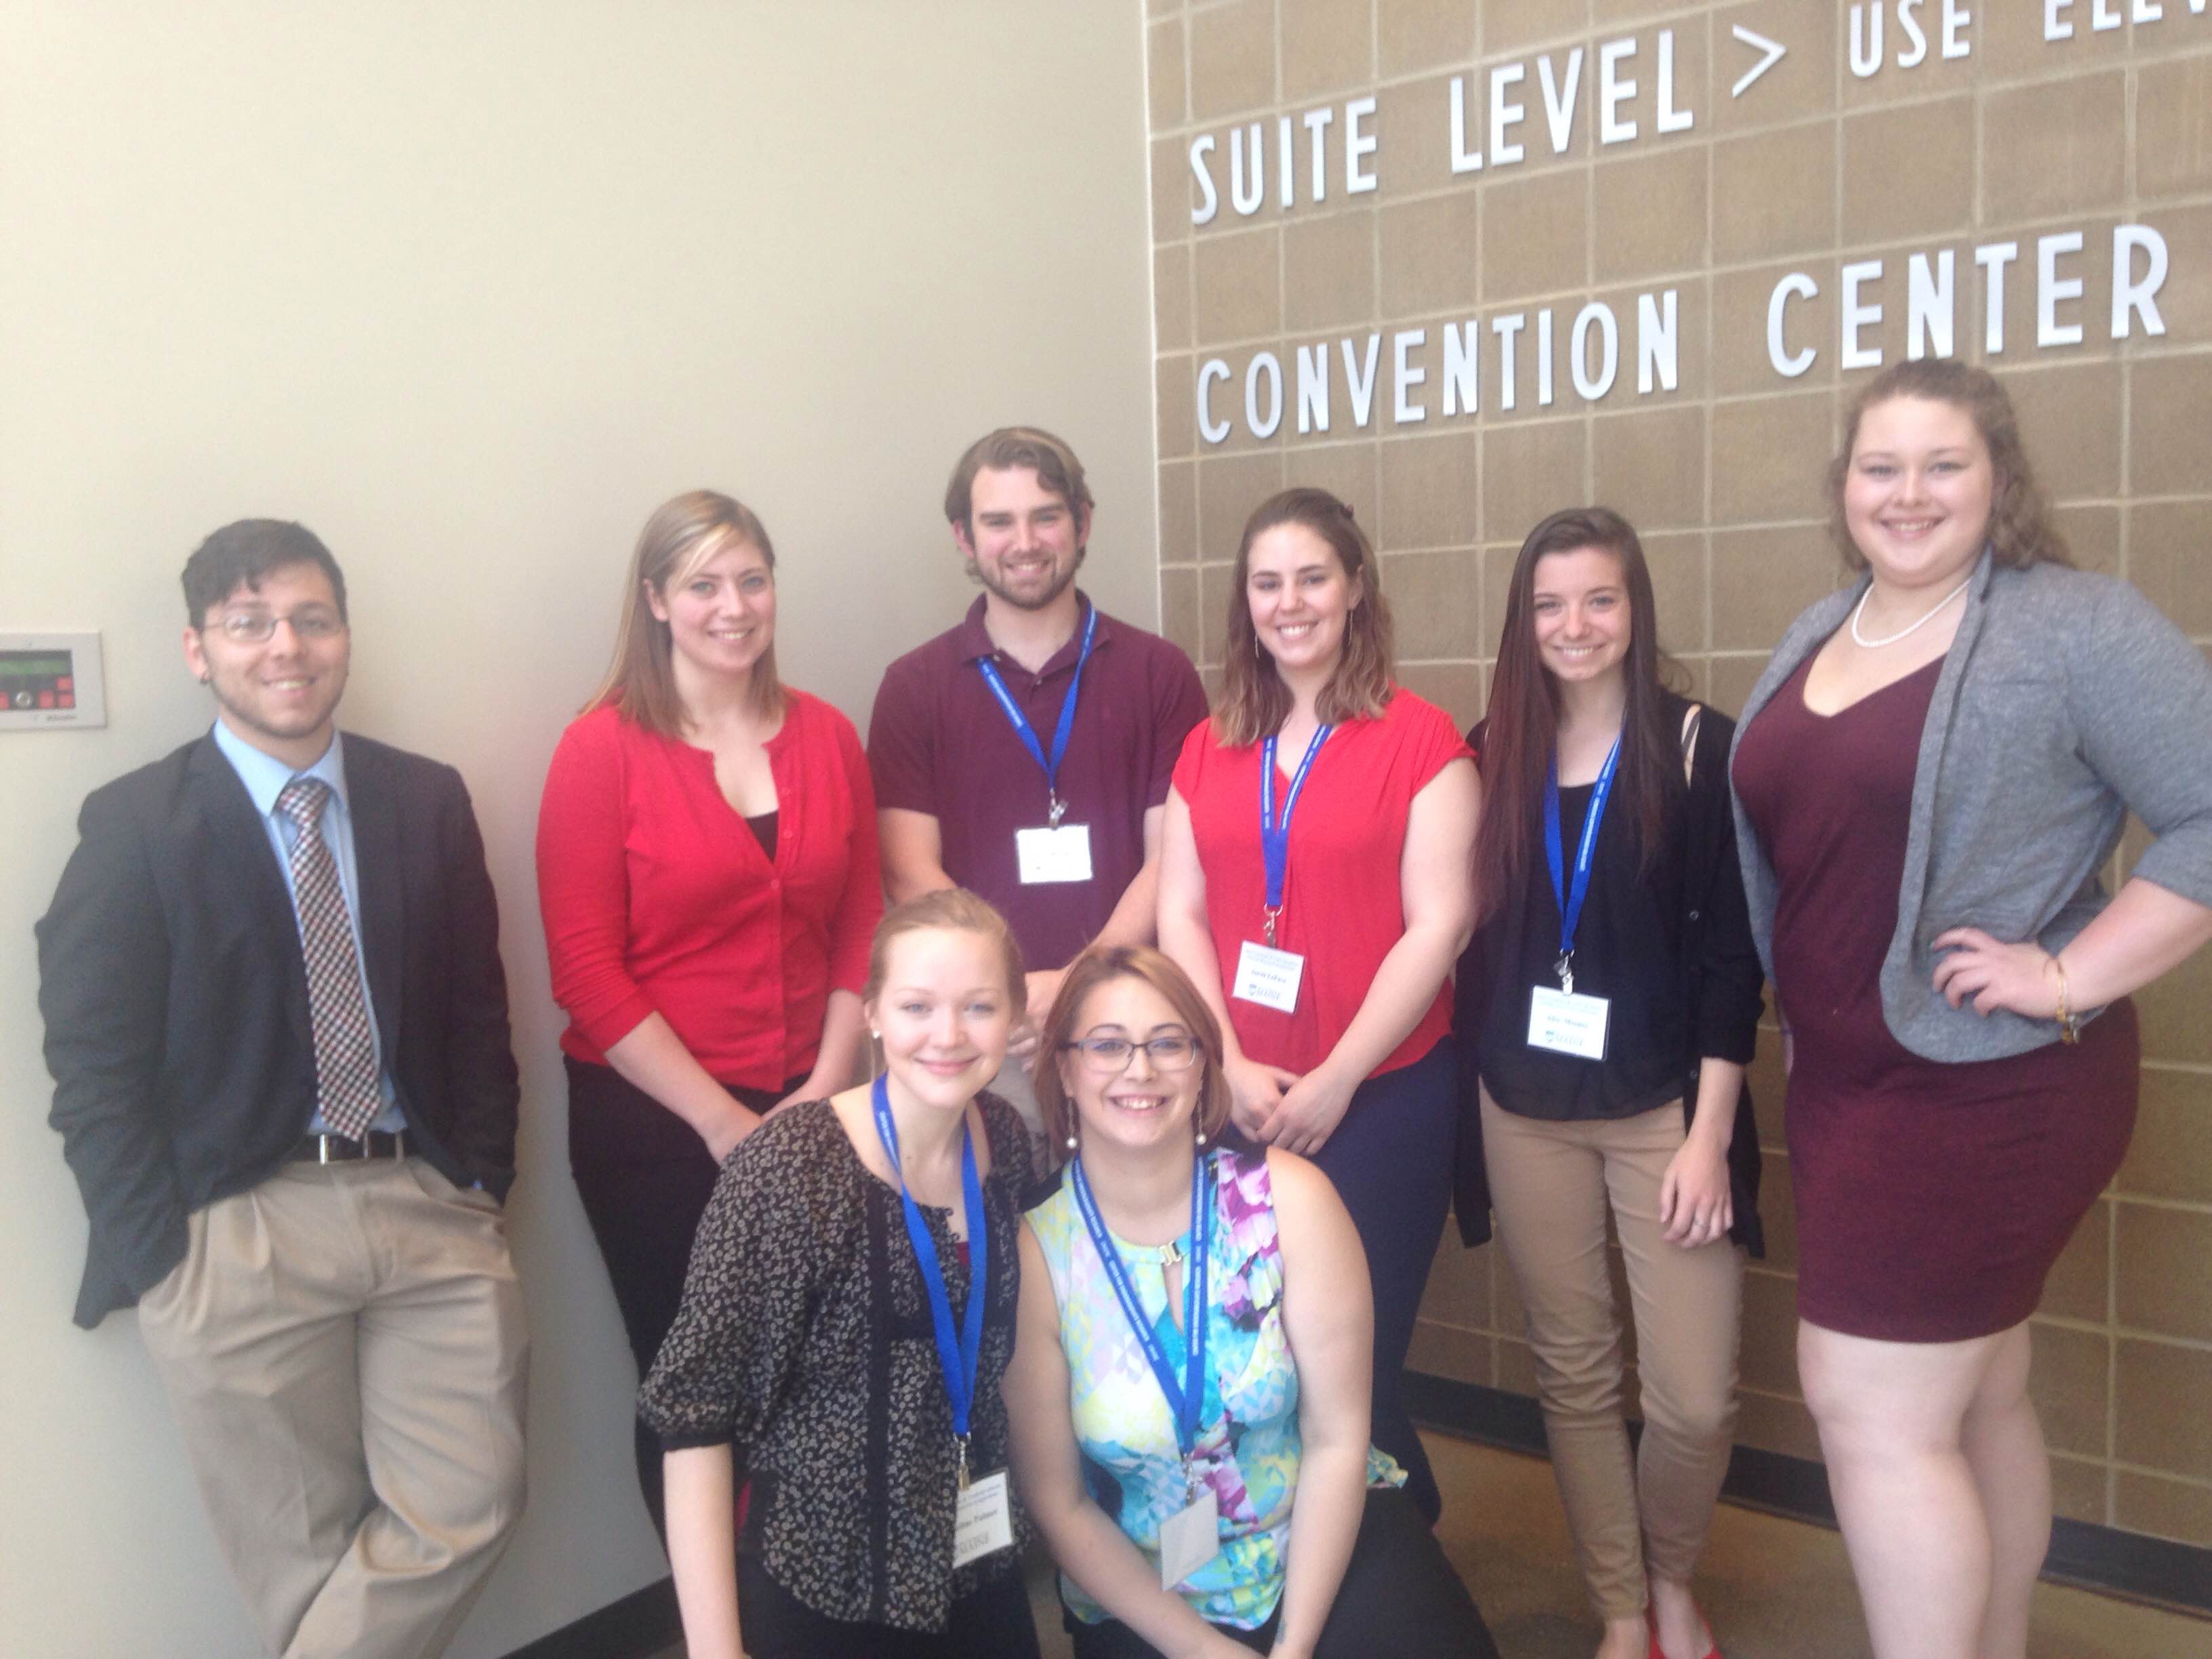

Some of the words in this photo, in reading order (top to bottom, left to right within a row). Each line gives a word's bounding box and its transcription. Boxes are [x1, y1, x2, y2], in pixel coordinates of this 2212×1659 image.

[1188, 95, 1378, 225] SUITE
[1449, 28, 1695, 175] LEVEL
[1849, 0, 1971, 77] USE
[1195, 288, 1679, 444] CONVENTION
[1765, 223, 2170, 377] CENTER
